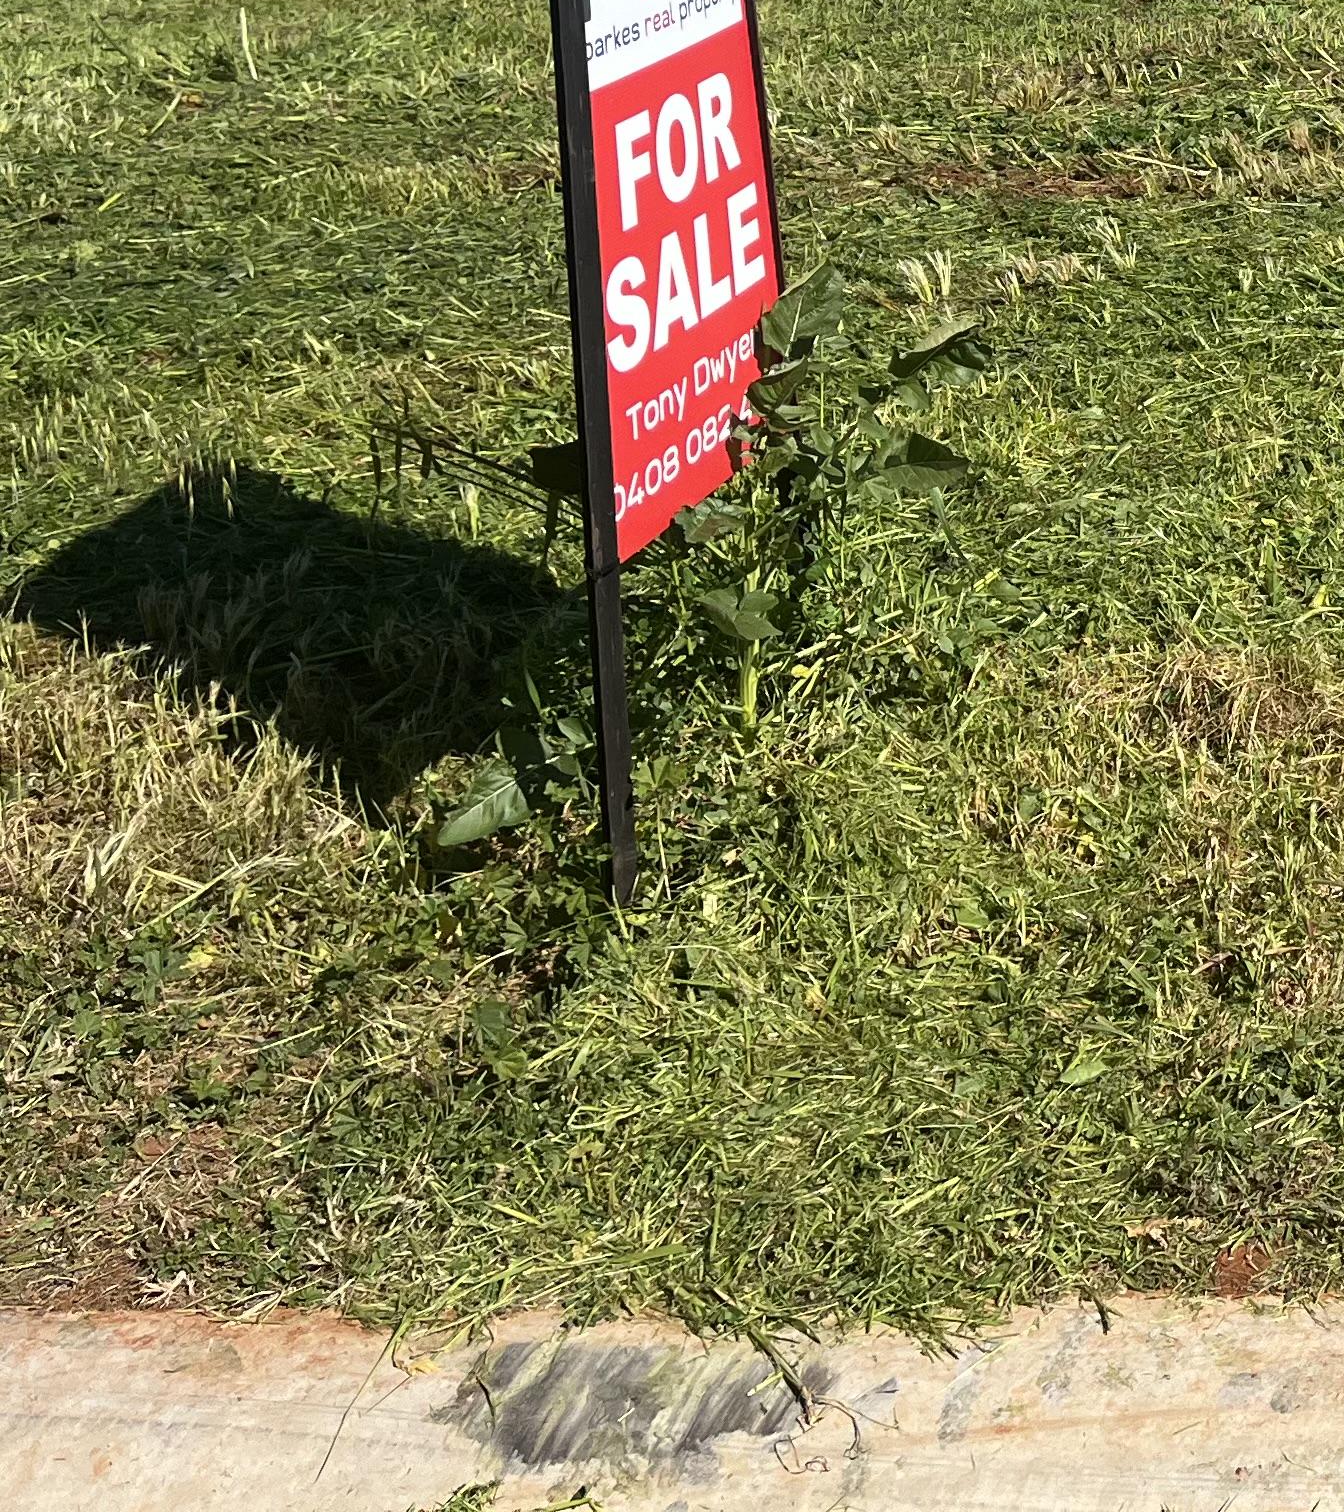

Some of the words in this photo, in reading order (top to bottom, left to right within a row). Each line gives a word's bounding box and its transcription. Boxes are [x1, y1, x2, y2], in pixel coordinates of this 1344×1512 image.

[585, 23, 641, 62] parkes
[644, 1, 676, 37] real
[615, 72, 742, 232] FOR
[606, 182, 766, 373] SALE
[625, 376, 688, 440] Tony
[613, 444, 680, 522] 0408
